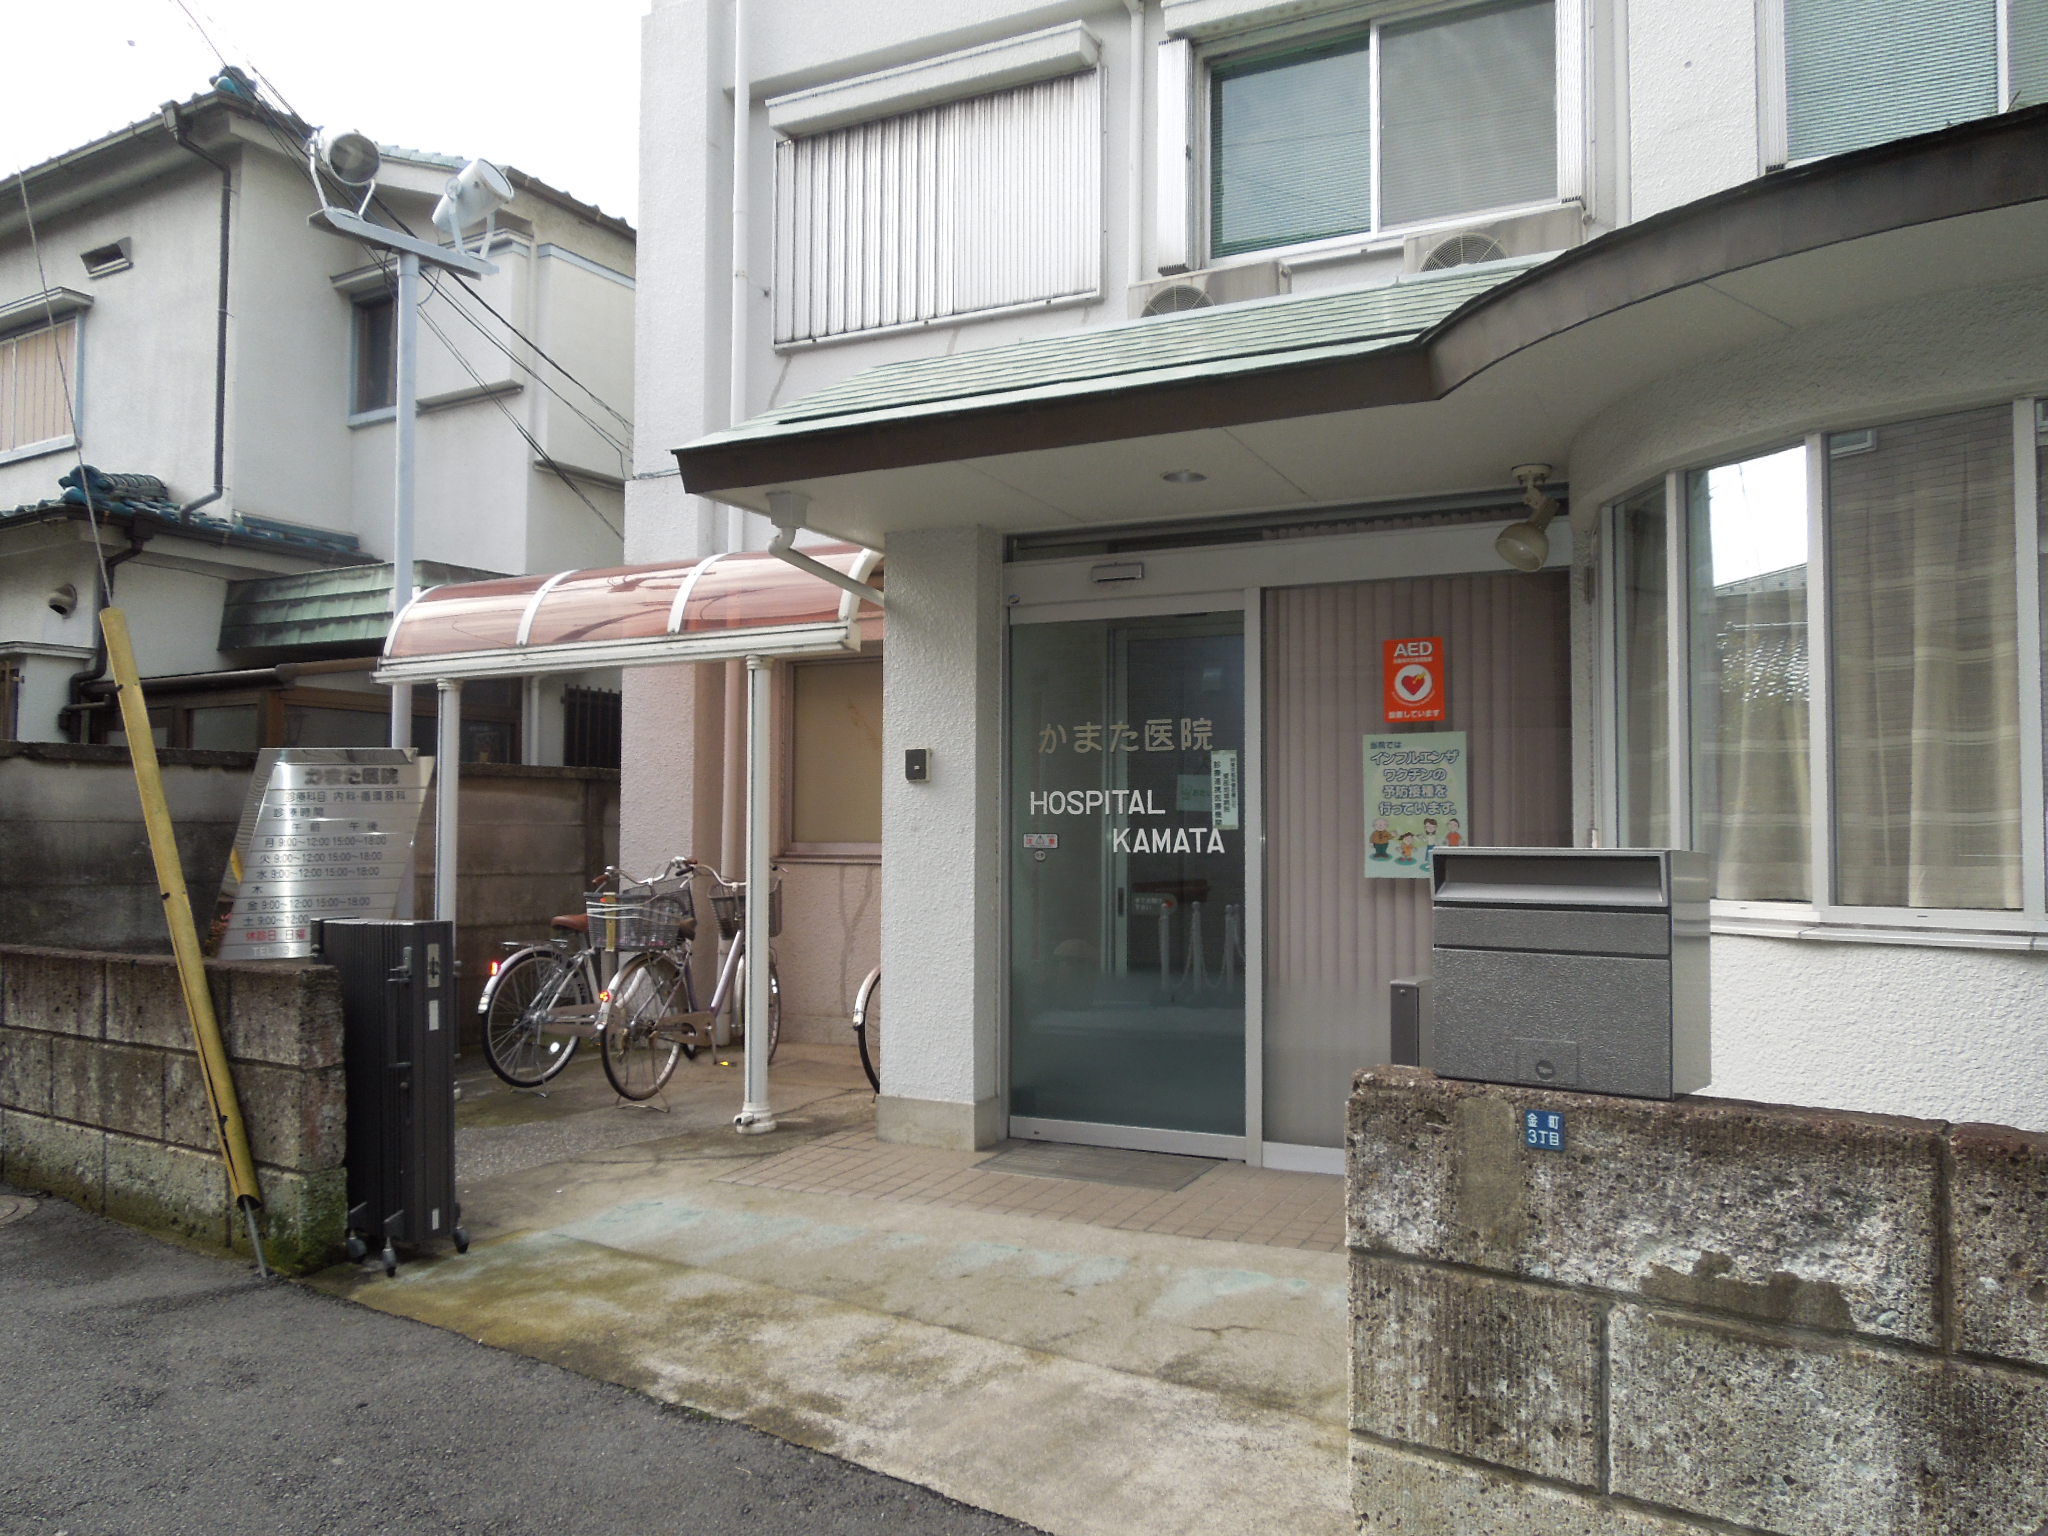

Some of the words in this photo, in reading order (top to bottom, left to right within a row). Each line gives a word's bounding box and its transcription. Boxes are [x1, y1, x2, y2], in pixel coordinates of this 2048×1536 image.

[1394, 641, 1433, 656] AED
[1038, 718, 1214, 754] かまた医院
[1370, 749, 1460, 765] インフルエンザ
[1384, 768, 1448, 782] ワクチンの
[286, 790, 326, 803] 診療科目
[1382, 784, 1448, 799] 予防接種を
[1030, 790, 1166, 815] HOSPITAL
[264, 838, 274, 848] 月
[1112, 828, 1225, 854] KAMATA
[260, 855, 270, 864] 火
[256, 870, 267, 880] 水
[252, 886, 262, 894] 木
[248, 900, 258, 911] 金
[244, 918, 254, 926] 土
[1528, 1113, 1560, 1129] 金町
[1528, 1129, 1560, 1146] 3丁目
